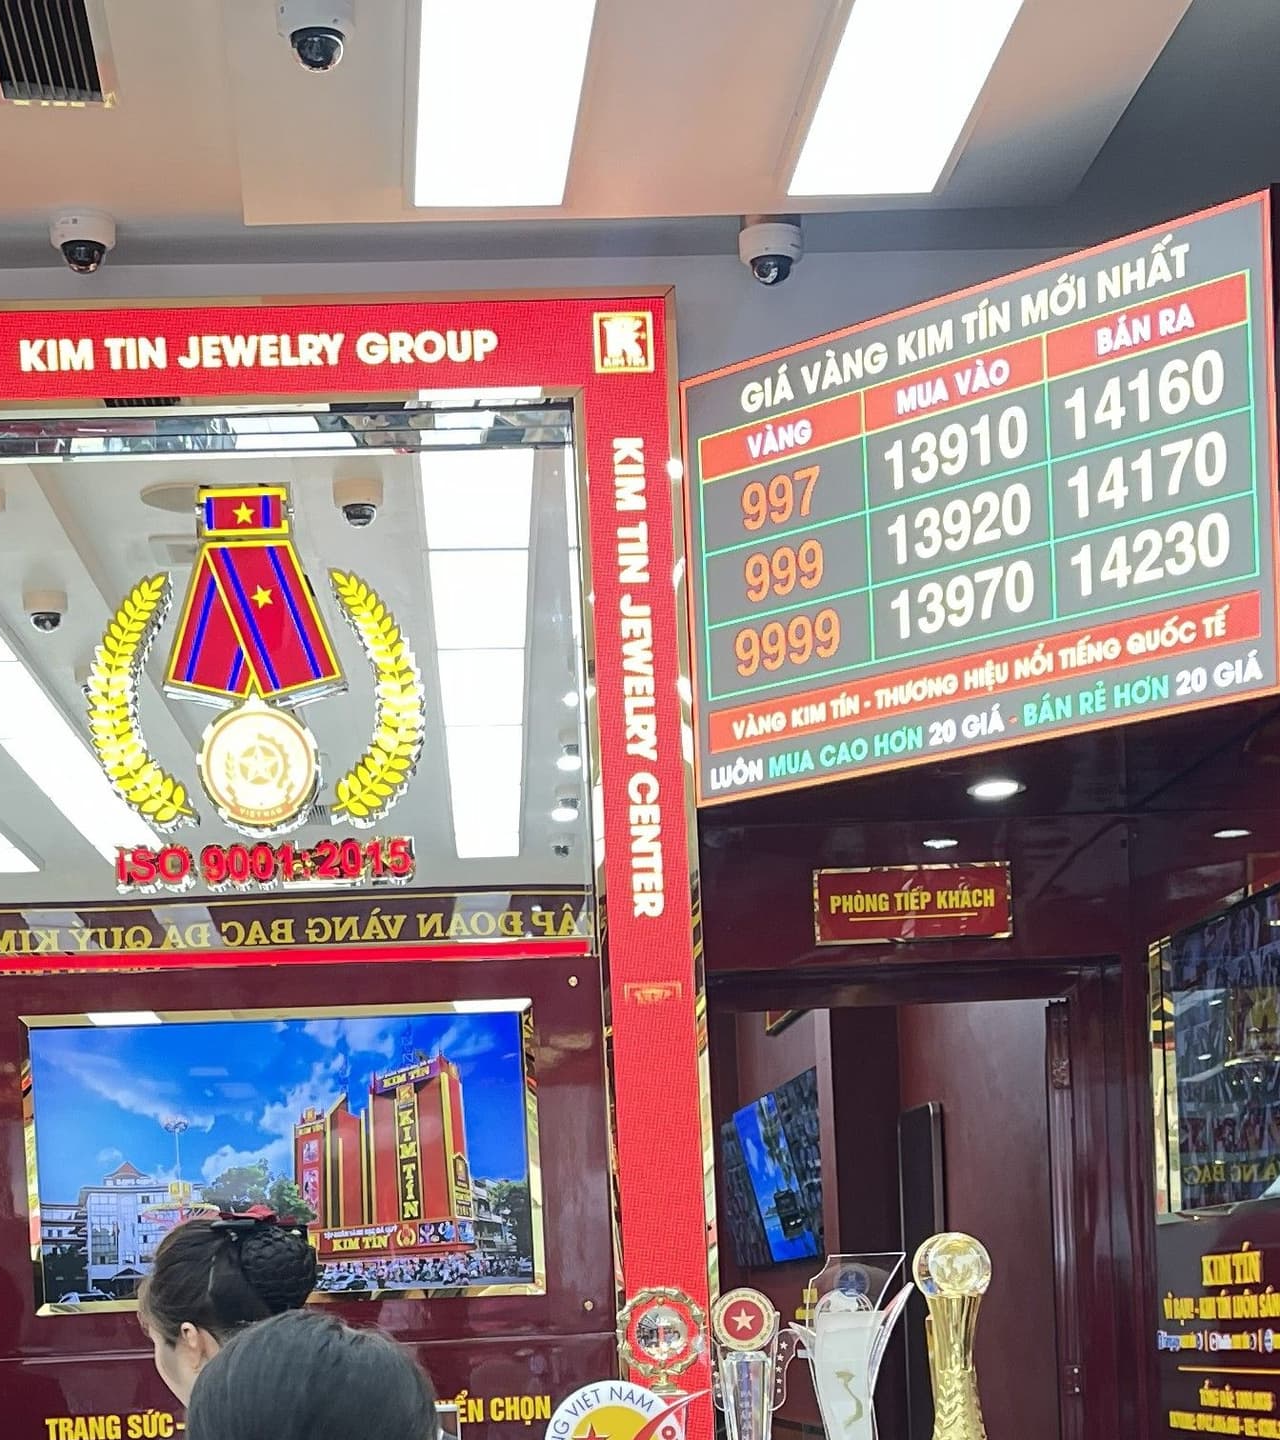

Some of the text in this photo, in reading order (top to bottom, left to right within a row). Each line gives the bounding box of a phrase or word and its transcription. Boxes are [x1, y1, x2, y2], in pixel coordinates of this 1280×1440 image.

[19, 329, 498, 373] KIM TIN JEWELRY GROUP
[741, 234, 1189, 413] GIÁ VÀNG KIM TÍN MỚI NHẤT
[747, 302, 1195, 459] VÀNG MUA VÀO BÁN RA
[742, 348, 1226, 531] 997 13910 14160
[744, 430, 1228, 602] 999 13920 14170
[734, 513, 1231, 678] 9999 13970 14230
[612, 436, 664, 919] KIM TIN JEWELRY CENTER
[710, 650, 1264, 792] LUÔN MUA CAO HƠN 20 GIÁ BÁN RẺ HƠN 20 GIÁ
[732, 605, 1229, 740] VÀNG KIM TÍN THƯƠNG HIỆU NỔI TIẾNG QUỐC TẾ
[118, 840, 415, 883] ISO 9001:2015
[830, 883, 996, 915] PHÒNG TIẾP KHÁCH
[1201, 1240, 1262, 1286] KIM TÍN
[127, 1408, 174, 1440] SỨC
[489, 1395, 552, 1426] CHỌN
[565, 1387, 602, 1417] VIỆT
[610, 1386, 655, 1413] NAM
